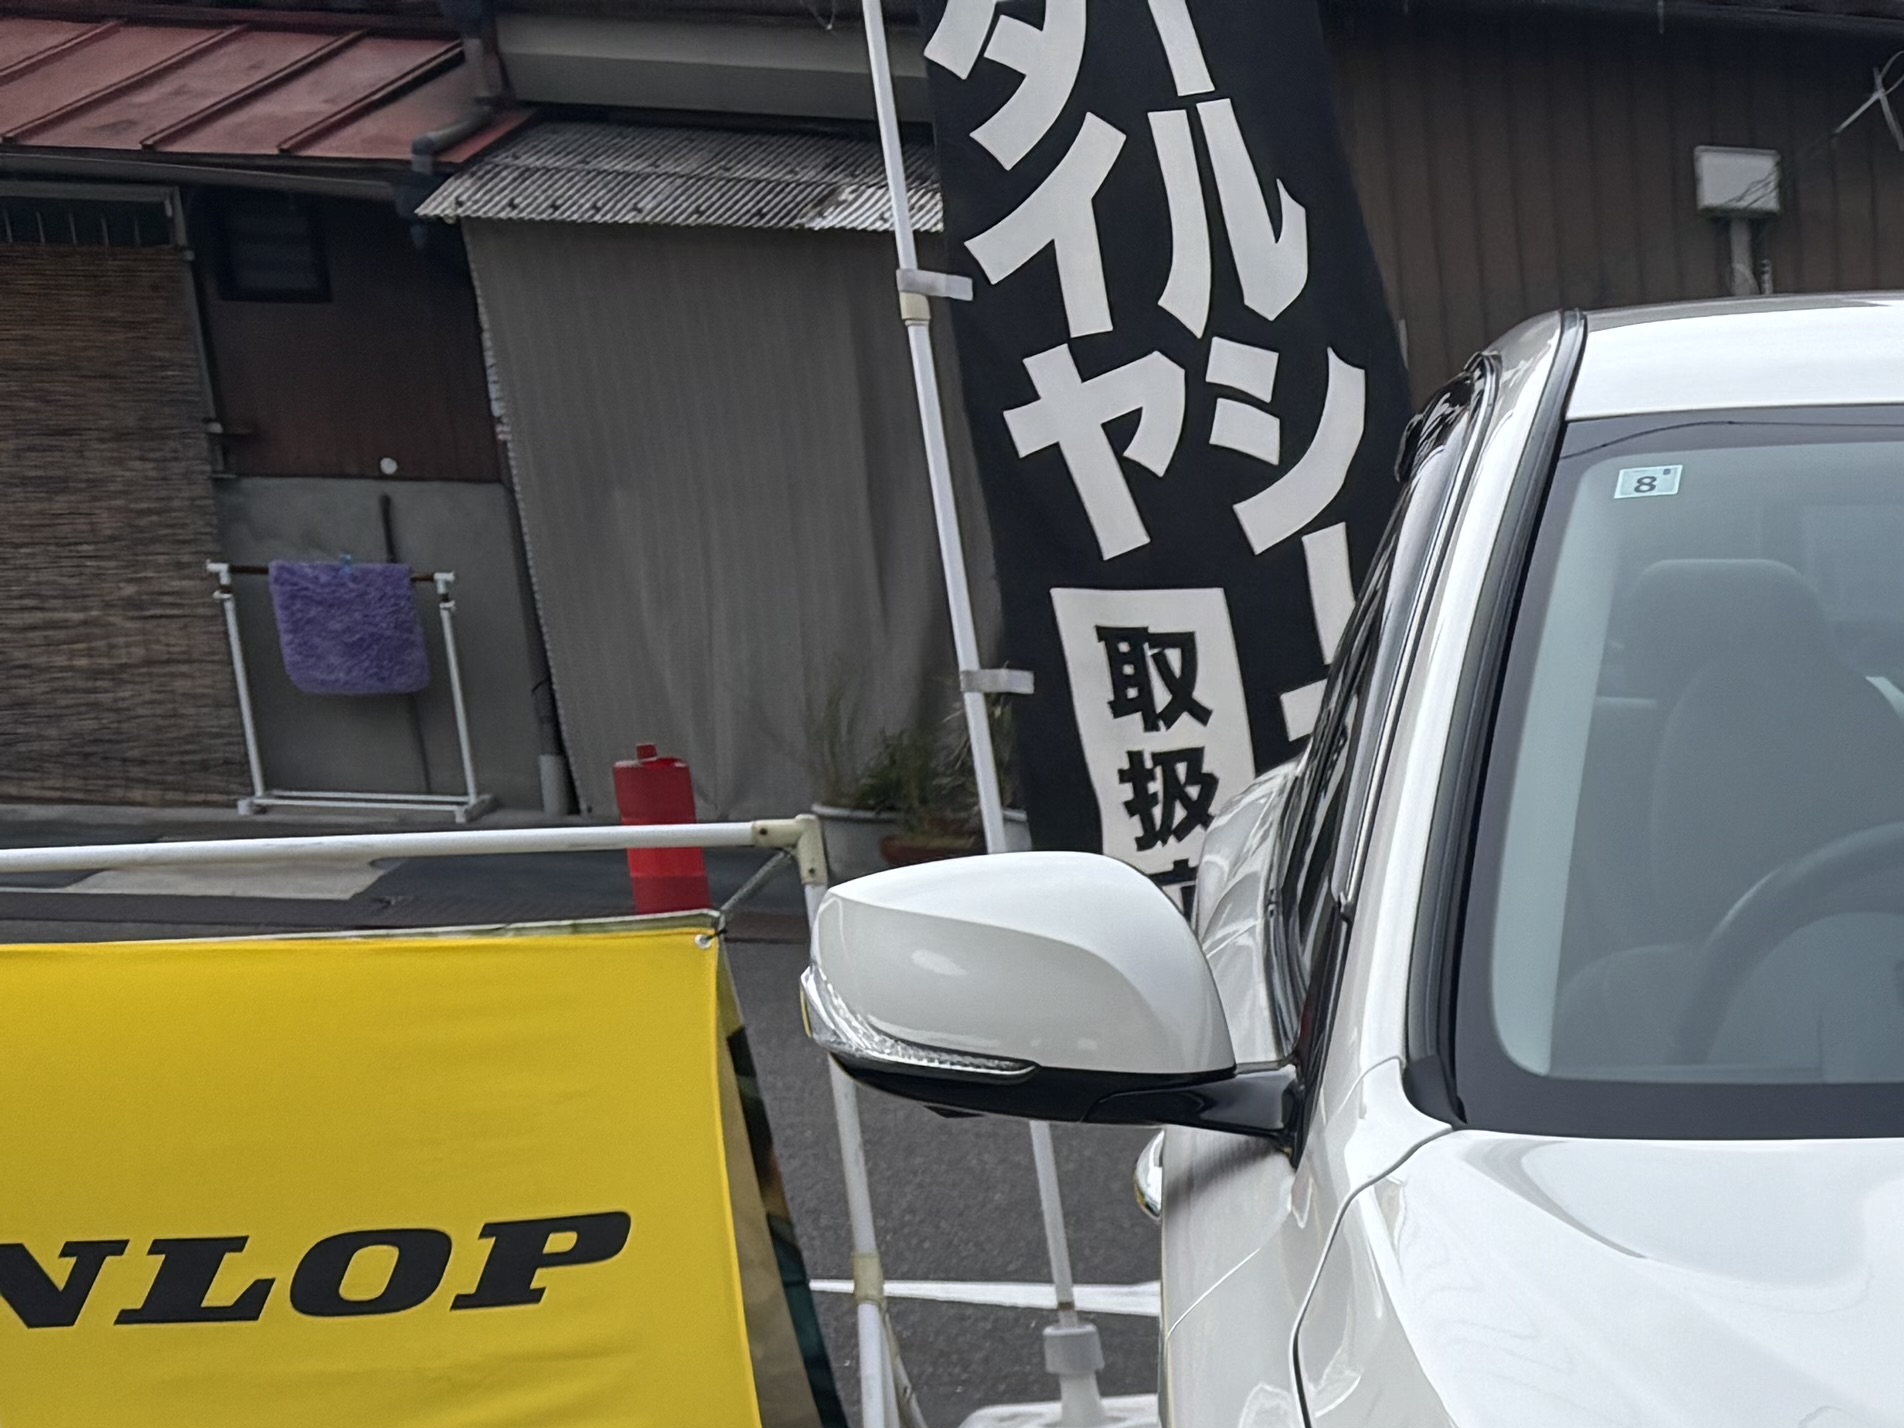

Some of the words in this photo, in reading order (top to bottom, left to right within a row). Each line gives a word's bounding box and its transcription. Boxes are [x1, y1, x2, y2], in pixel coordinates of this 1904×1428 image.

[924, 0, 1186, 561] タイヤ
[1147, 0, 1366, 742] ールシー
[1633, 476, 1657, 493] 8
[1095, 625, 1220, 922] 取扱
